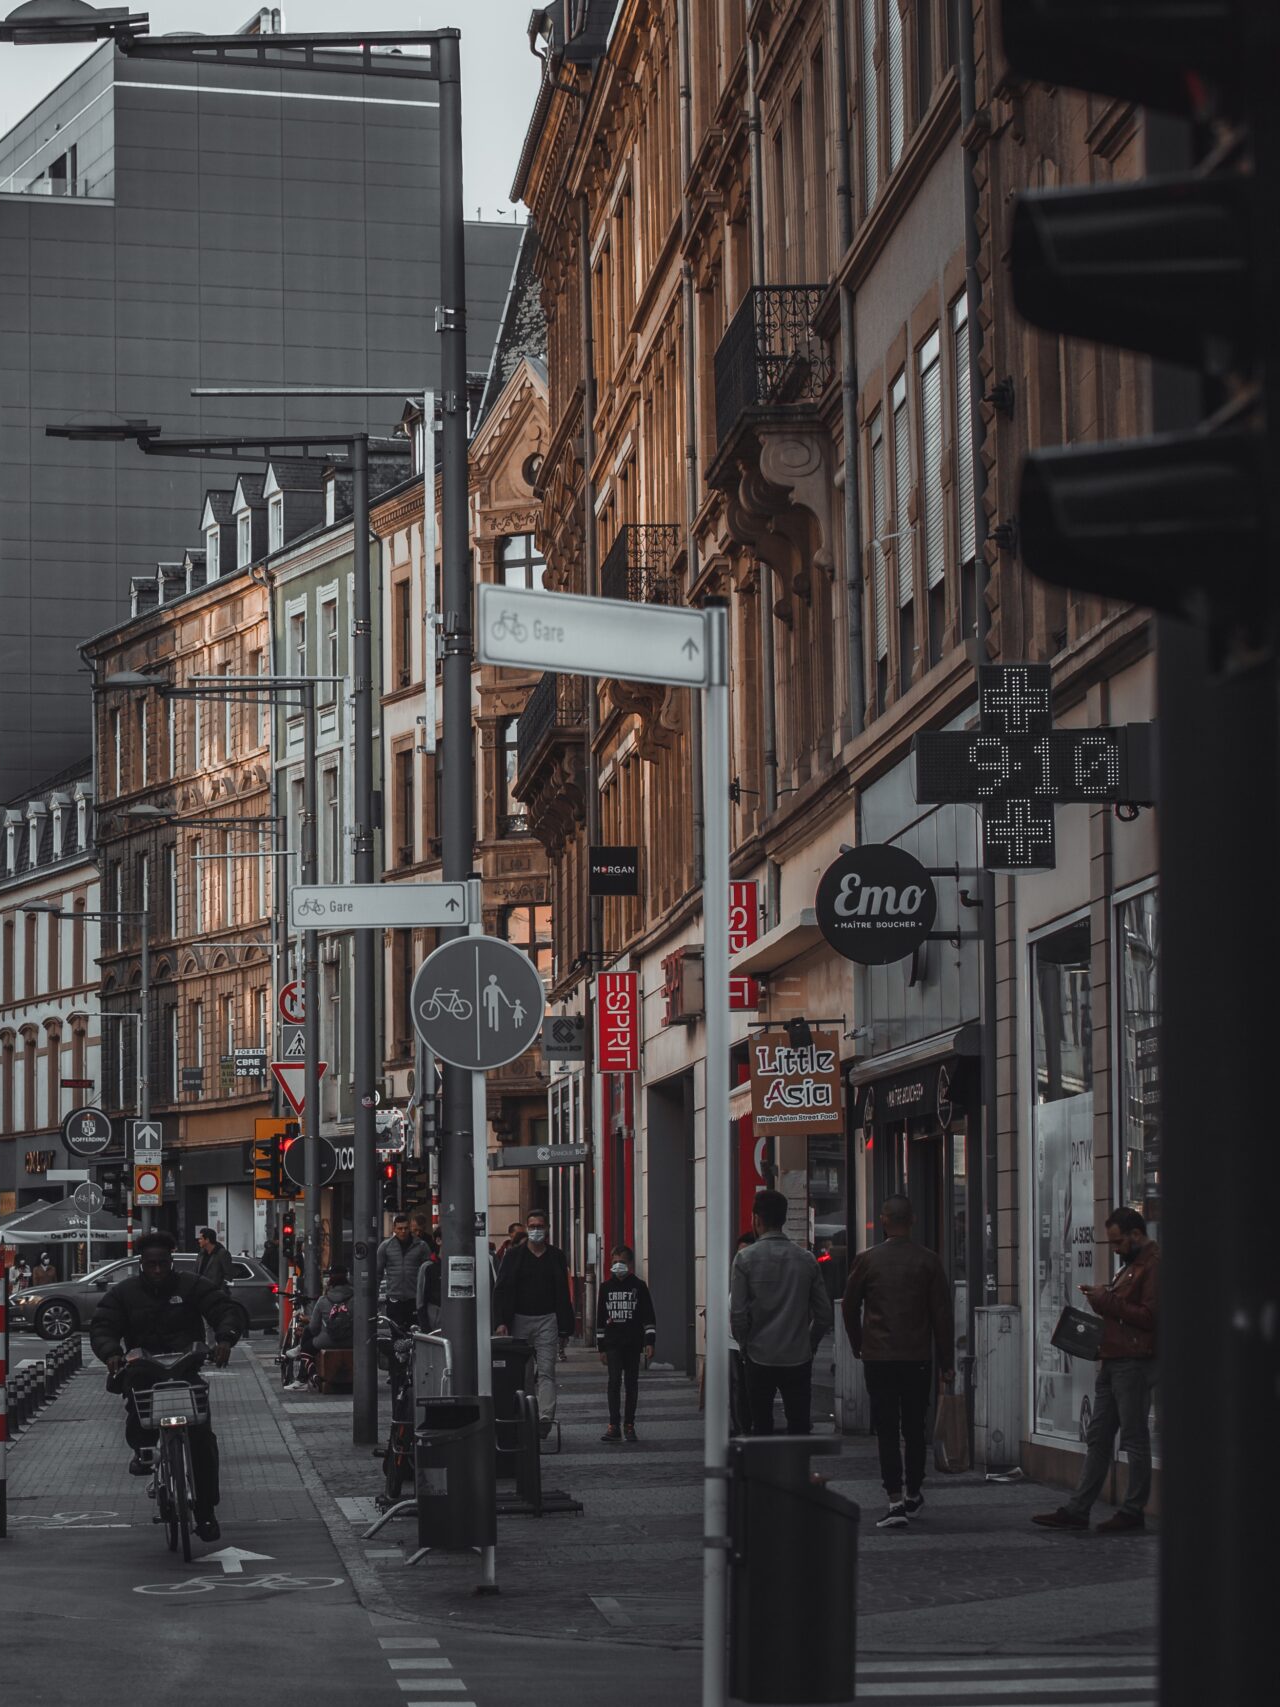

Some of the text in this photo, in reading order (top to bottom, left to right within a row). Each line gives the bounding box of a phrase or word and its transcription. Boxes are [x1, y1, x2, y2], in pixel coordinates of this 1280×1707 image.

[533, 619, 565, 643] Gare
[833, 872, 927, 917] Emo
[329, 900, 353, 912] Gare
[840, 920, 916, 929] MAÎTRE BOUCHER
[605, 975, 631, 1069] ESPRIT
[236, 1058, 261, 1066] CBRE
[755, 1043, 835, 1076] Little
[248, 1068, 260, 1076] 26
[764, 1079, 832, 1109] Asia
[757, 1115, 778, 1123] Mixed
[606, 1300, 637, 1311] WITHOUT
